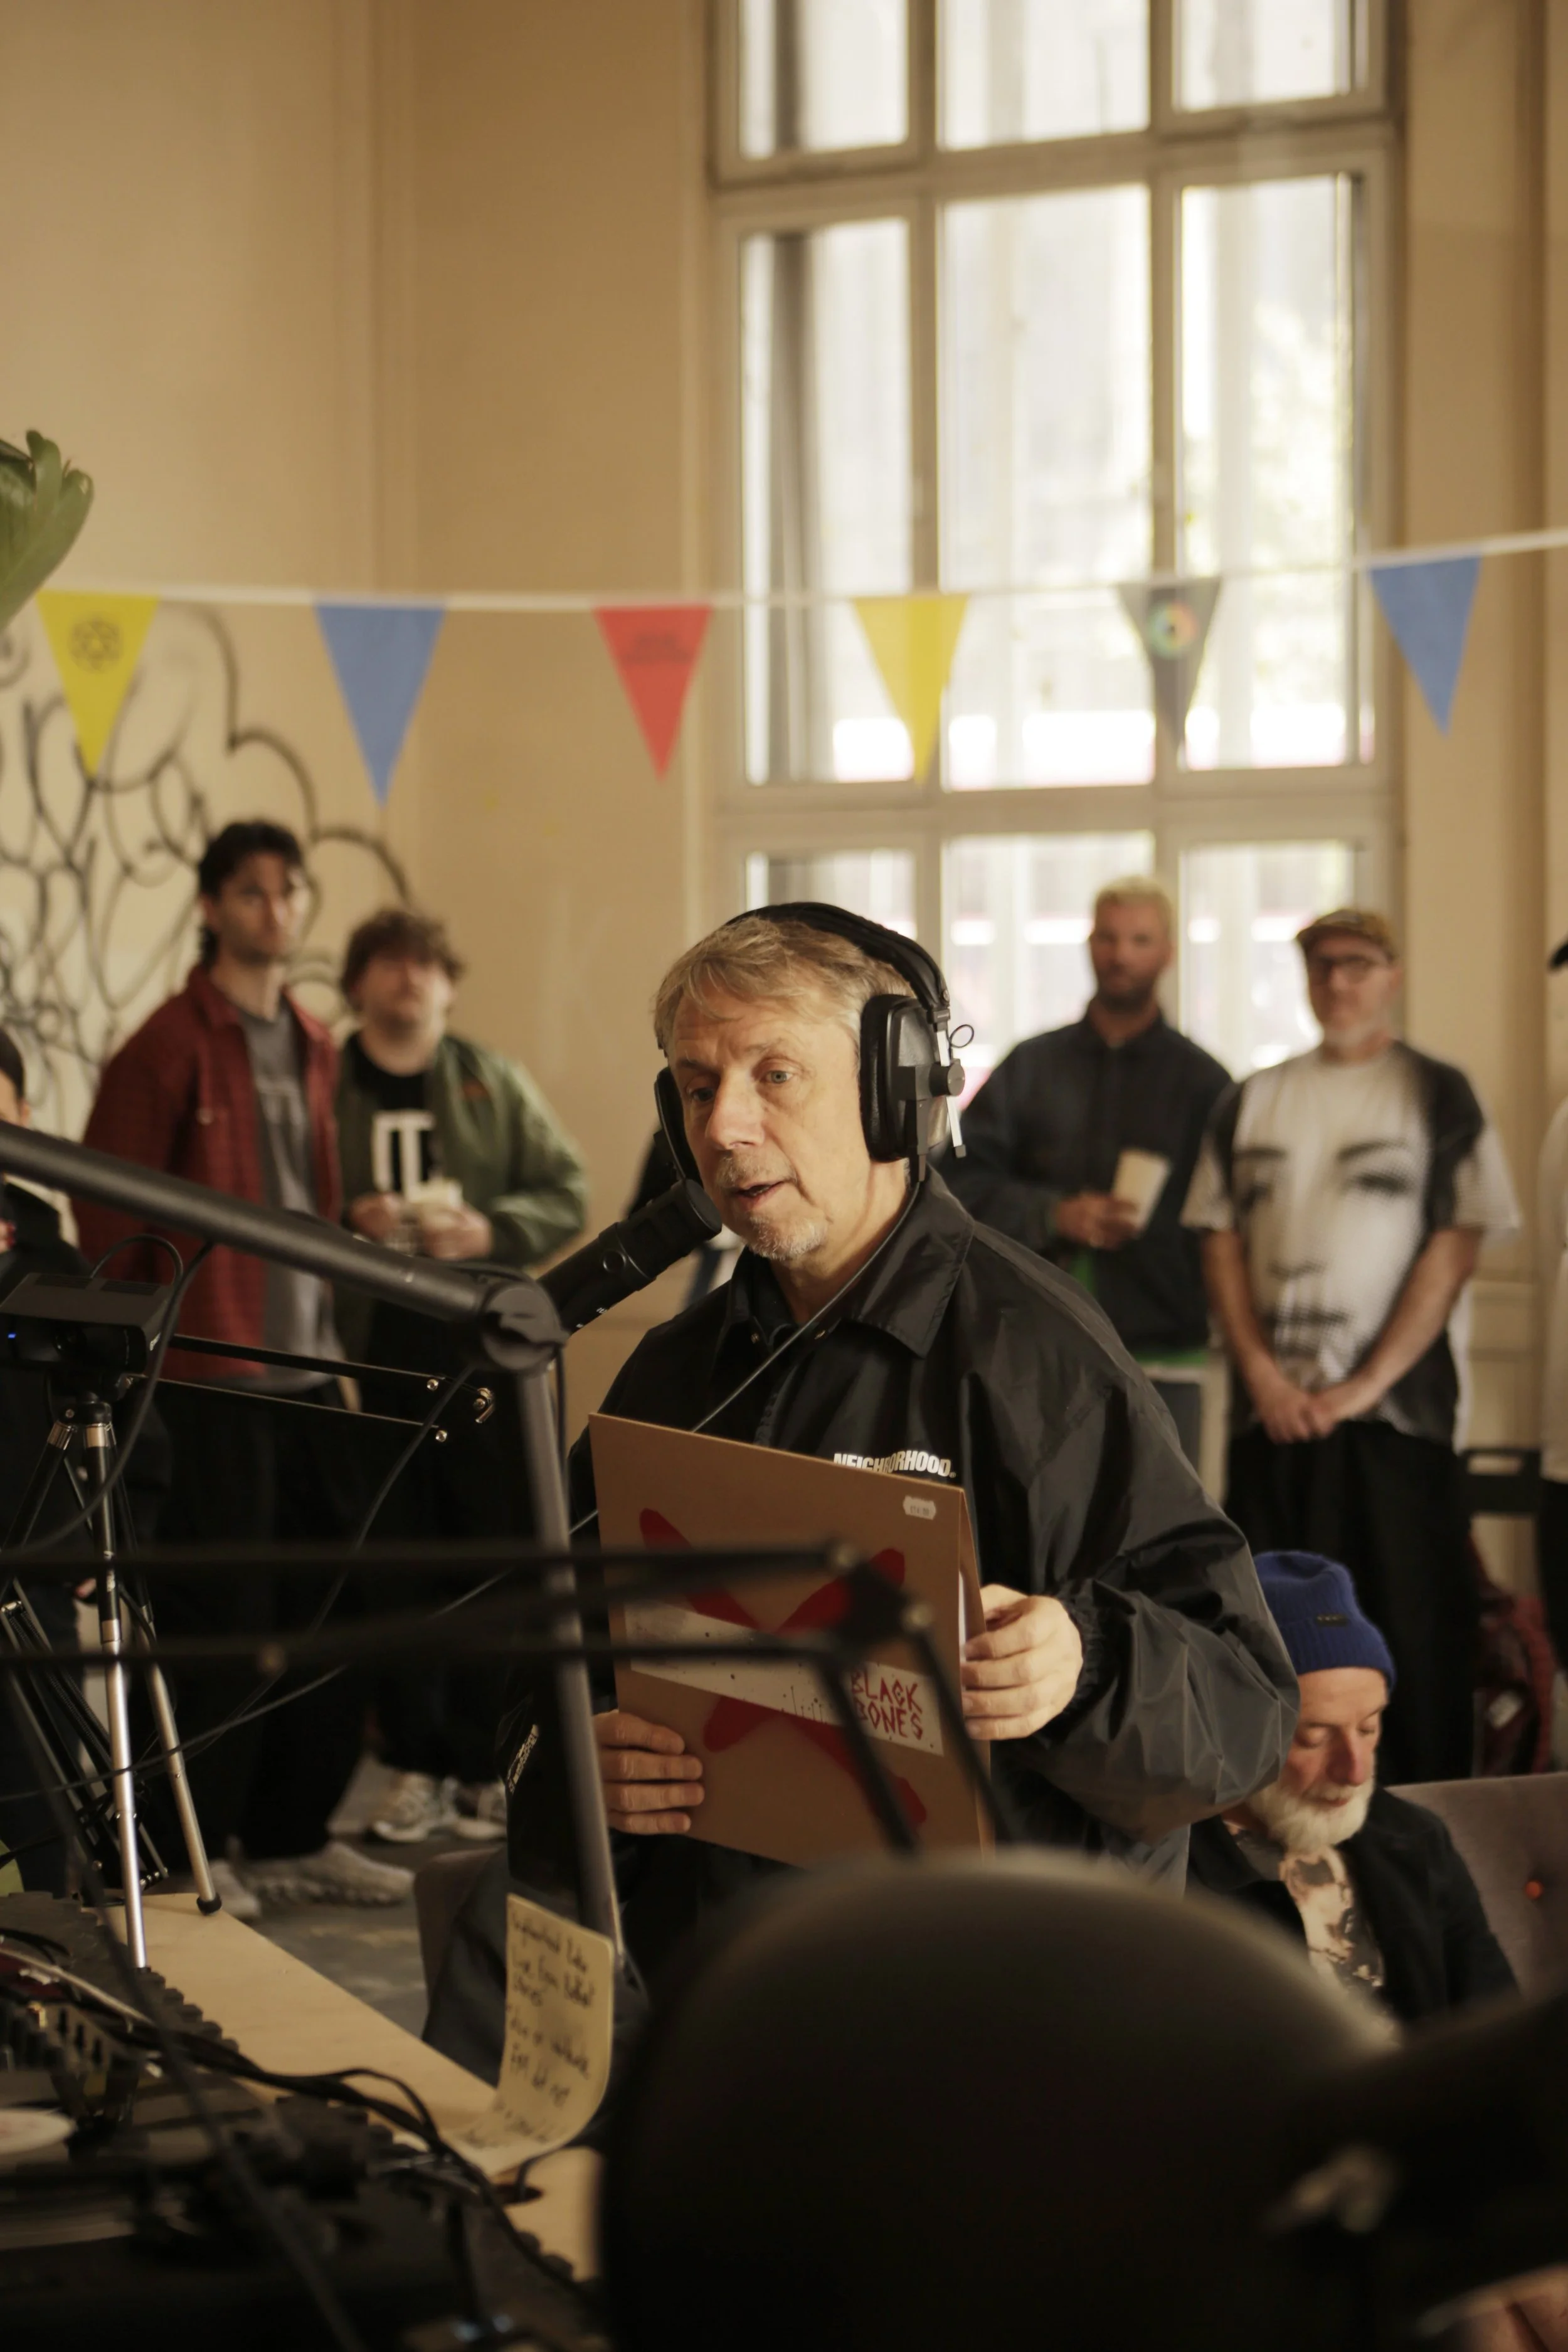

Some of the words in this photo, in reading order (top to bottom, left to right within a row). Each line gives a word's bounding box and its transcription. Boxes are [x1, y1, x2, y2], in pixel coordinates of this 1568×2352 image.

[834, 1450, 951, 1477] NEIGHBORHOOD
[851, 1668, 922, 1714] BLACK
[854, 1697, 923, 1740] BONES
